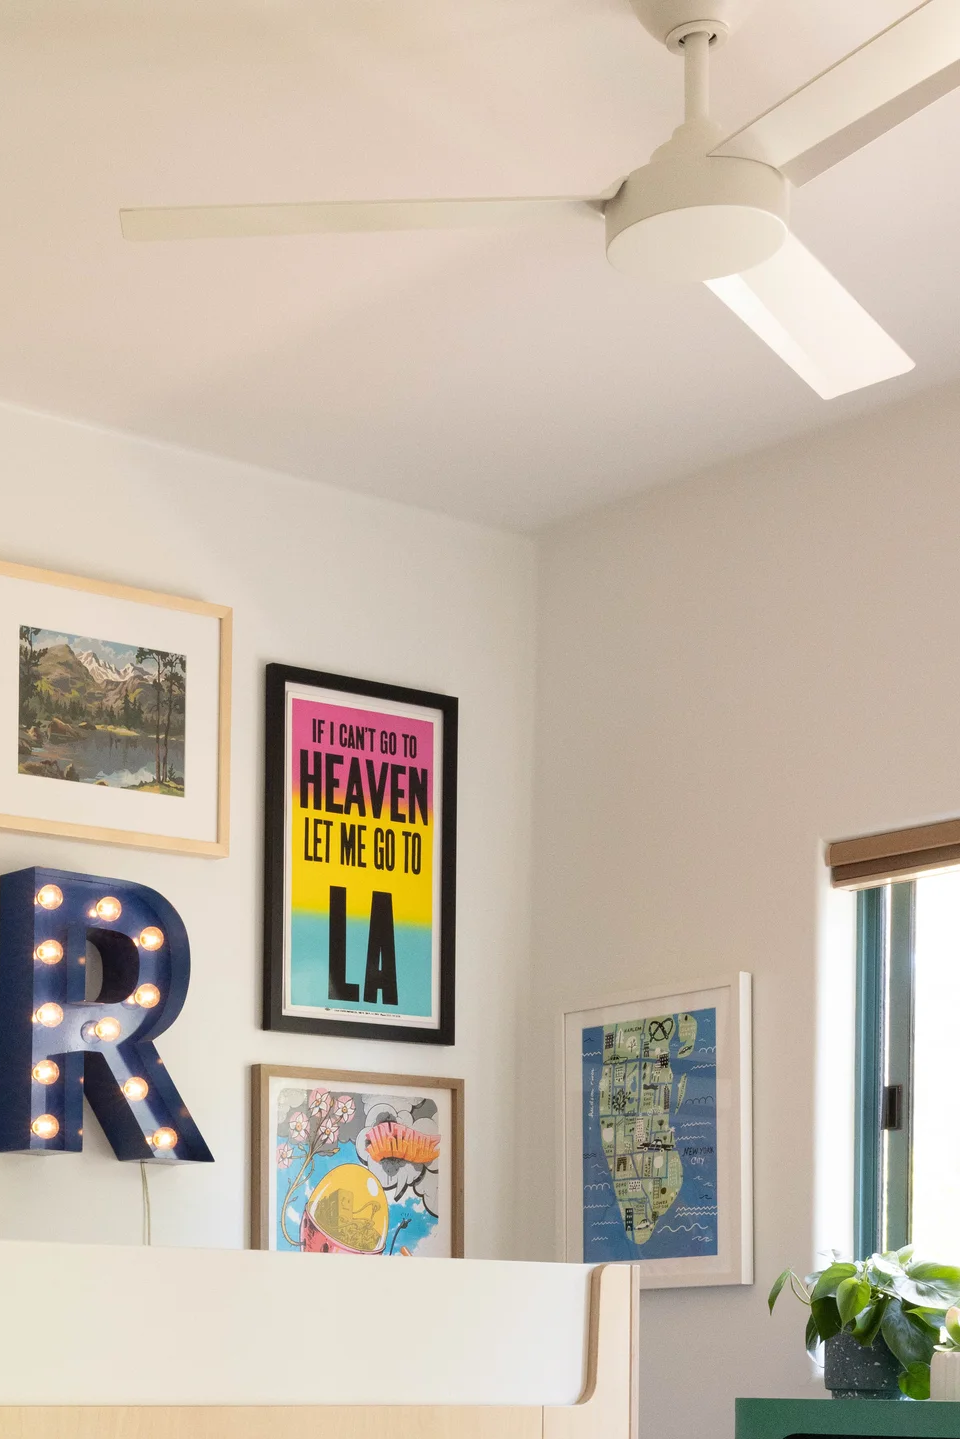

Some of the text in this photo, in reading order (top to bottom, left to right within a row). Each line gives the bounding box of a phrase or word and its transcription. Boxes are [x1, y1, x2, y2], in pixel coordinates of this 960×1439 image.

[312, 718, 418, 759] IF I CAN'T GO TO
[299, 749, 429, 826] HEAVEN
[304, 817, 422, 875] LET ME GO TO
[328, 885, 398, 1006] LA
[683, 1148, 698, 1156] NEW
